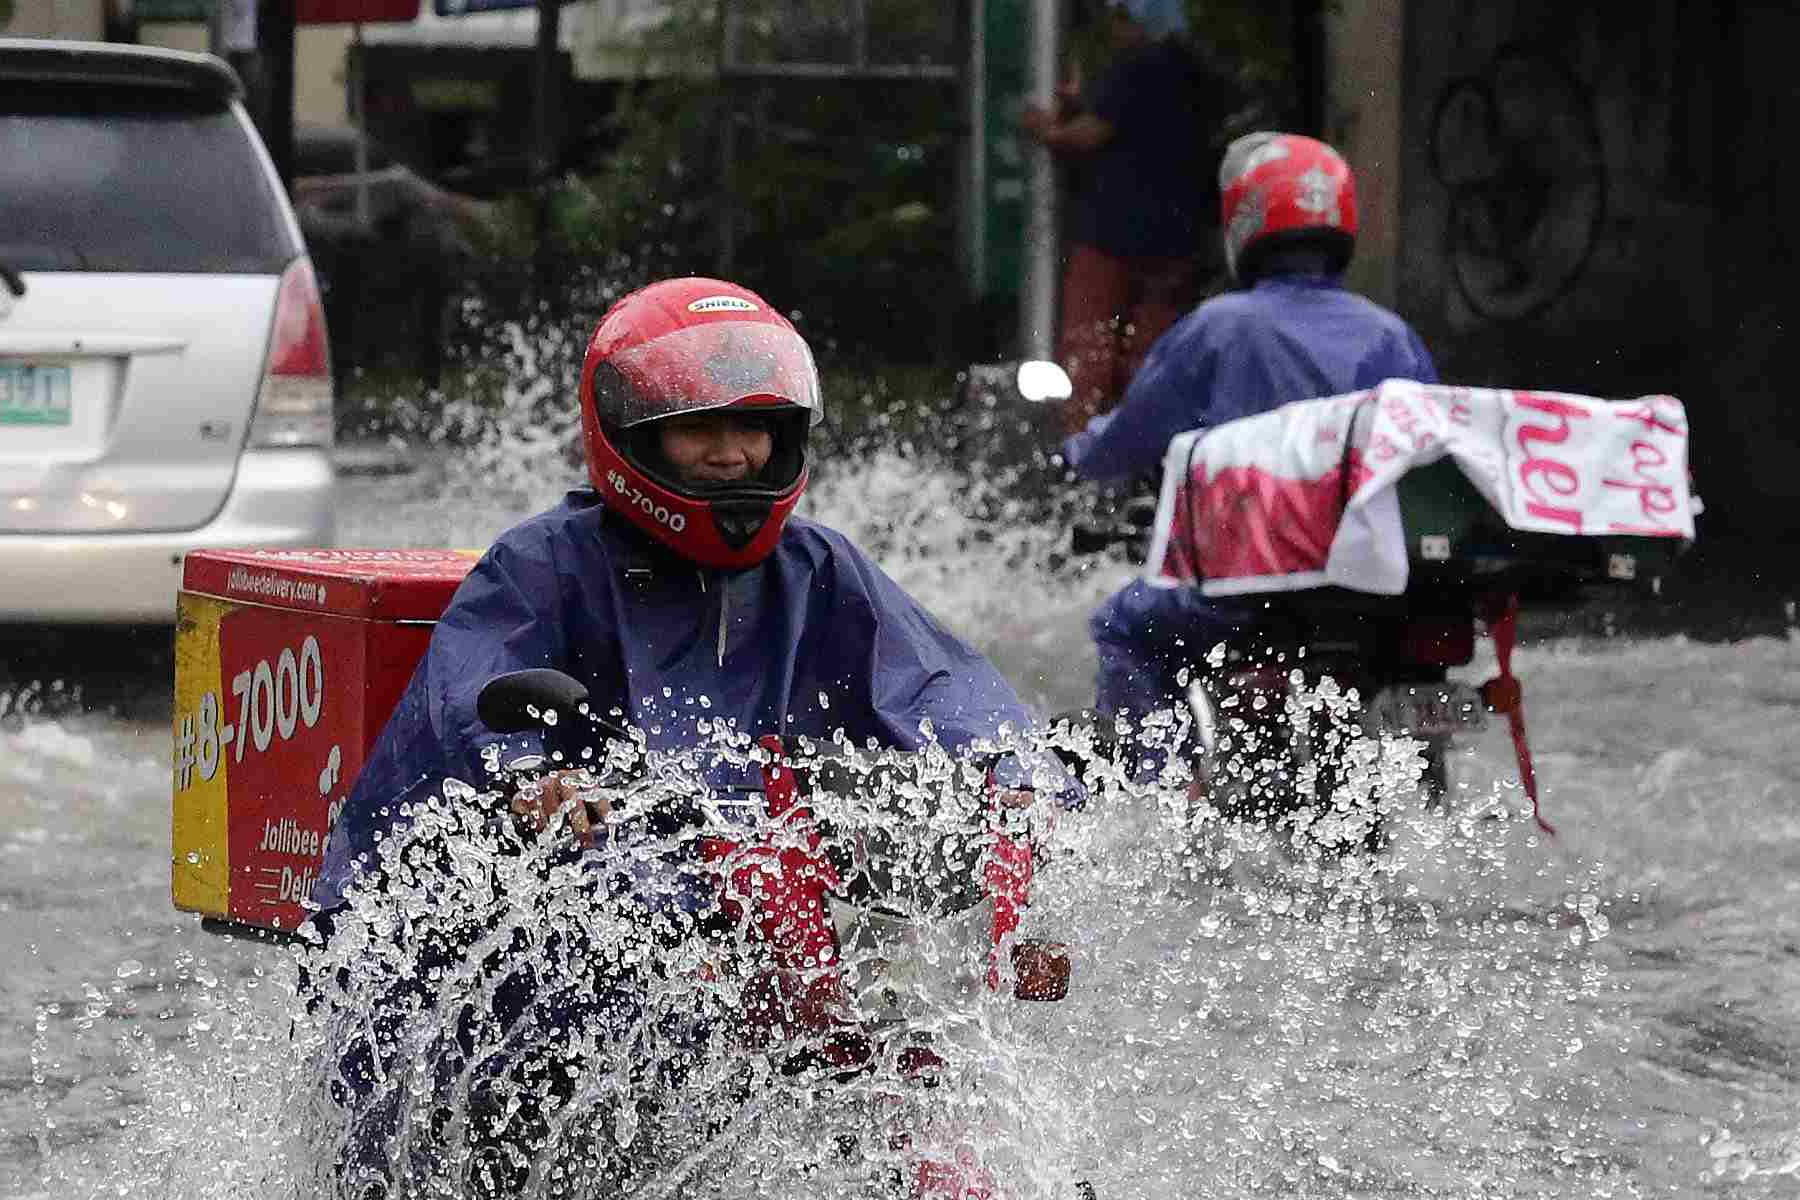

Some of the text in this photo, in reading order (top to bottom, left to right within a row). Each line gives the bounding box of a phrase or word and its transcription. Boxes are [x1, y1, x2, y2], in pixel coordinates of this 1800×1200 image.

[694, 300, 750, 311] SHIELD
[607, 469, 687, 533] #8-7000
[226, 567, 317, 601] jollibeedelivery.com
[177, 635, 323, 792] #8-7000
[260, 817, 319, 857] Jollibee
[280, 866, 316, 904] Deli
